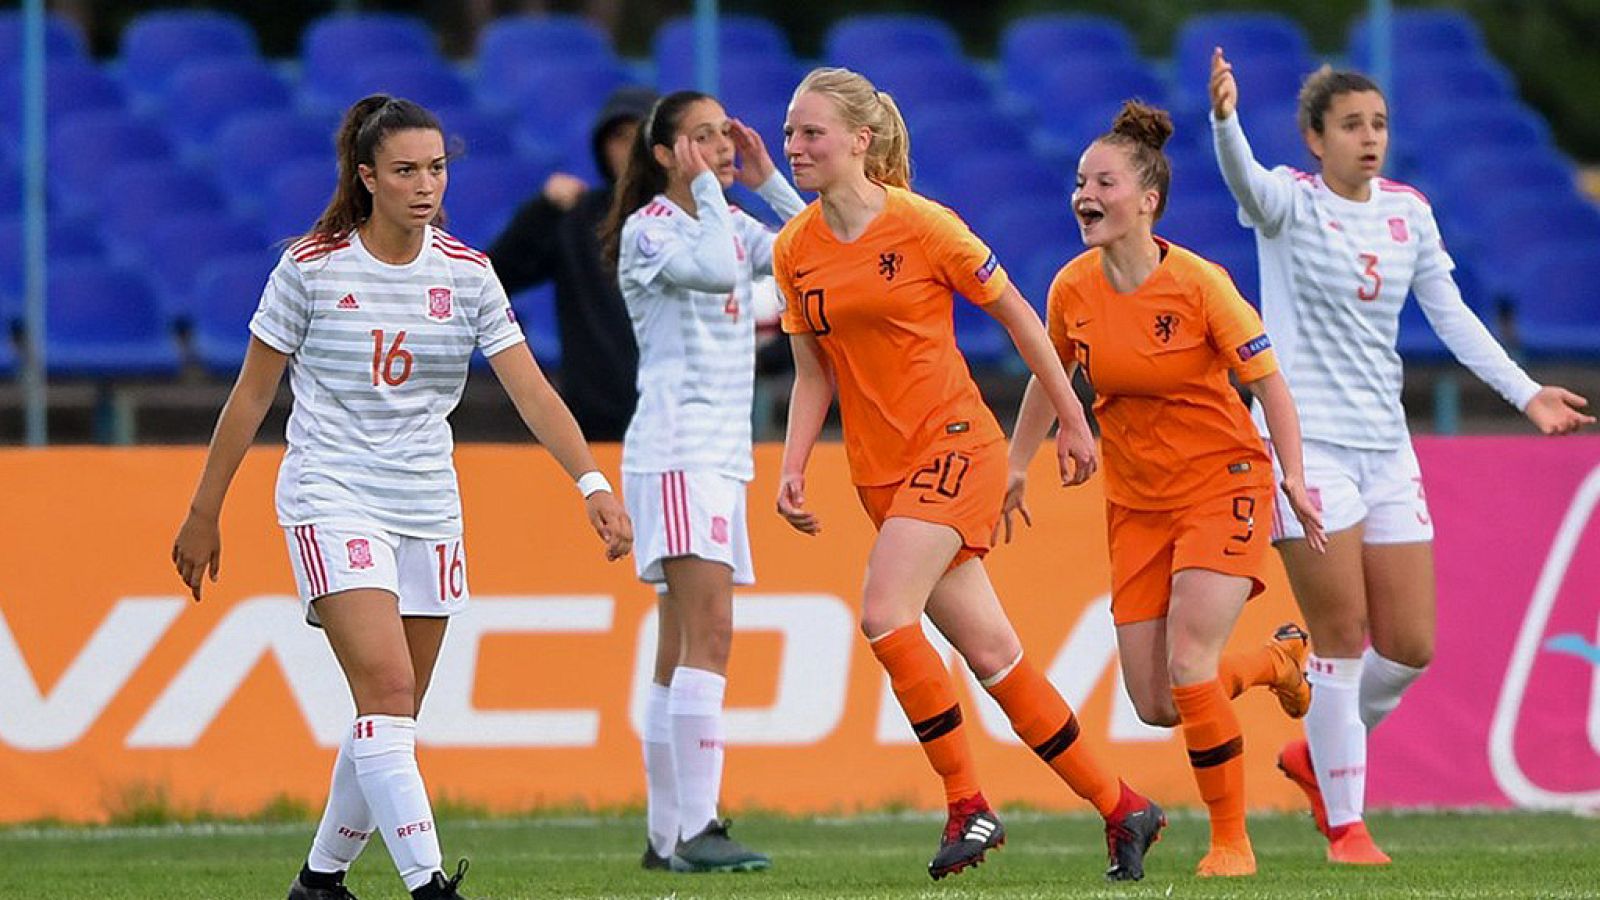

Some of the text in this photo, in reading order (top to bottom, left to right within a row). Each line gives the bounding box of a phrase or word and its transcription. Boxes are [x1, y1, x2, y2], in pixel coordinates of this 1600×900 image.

[1357, 253, 1382, 301] 3
[370, 329, 413, 387] 16
[910, 451, 969, 499] 20
[1231, 496, 1255, 542] 9
[435, 541, 463, 601] 16
